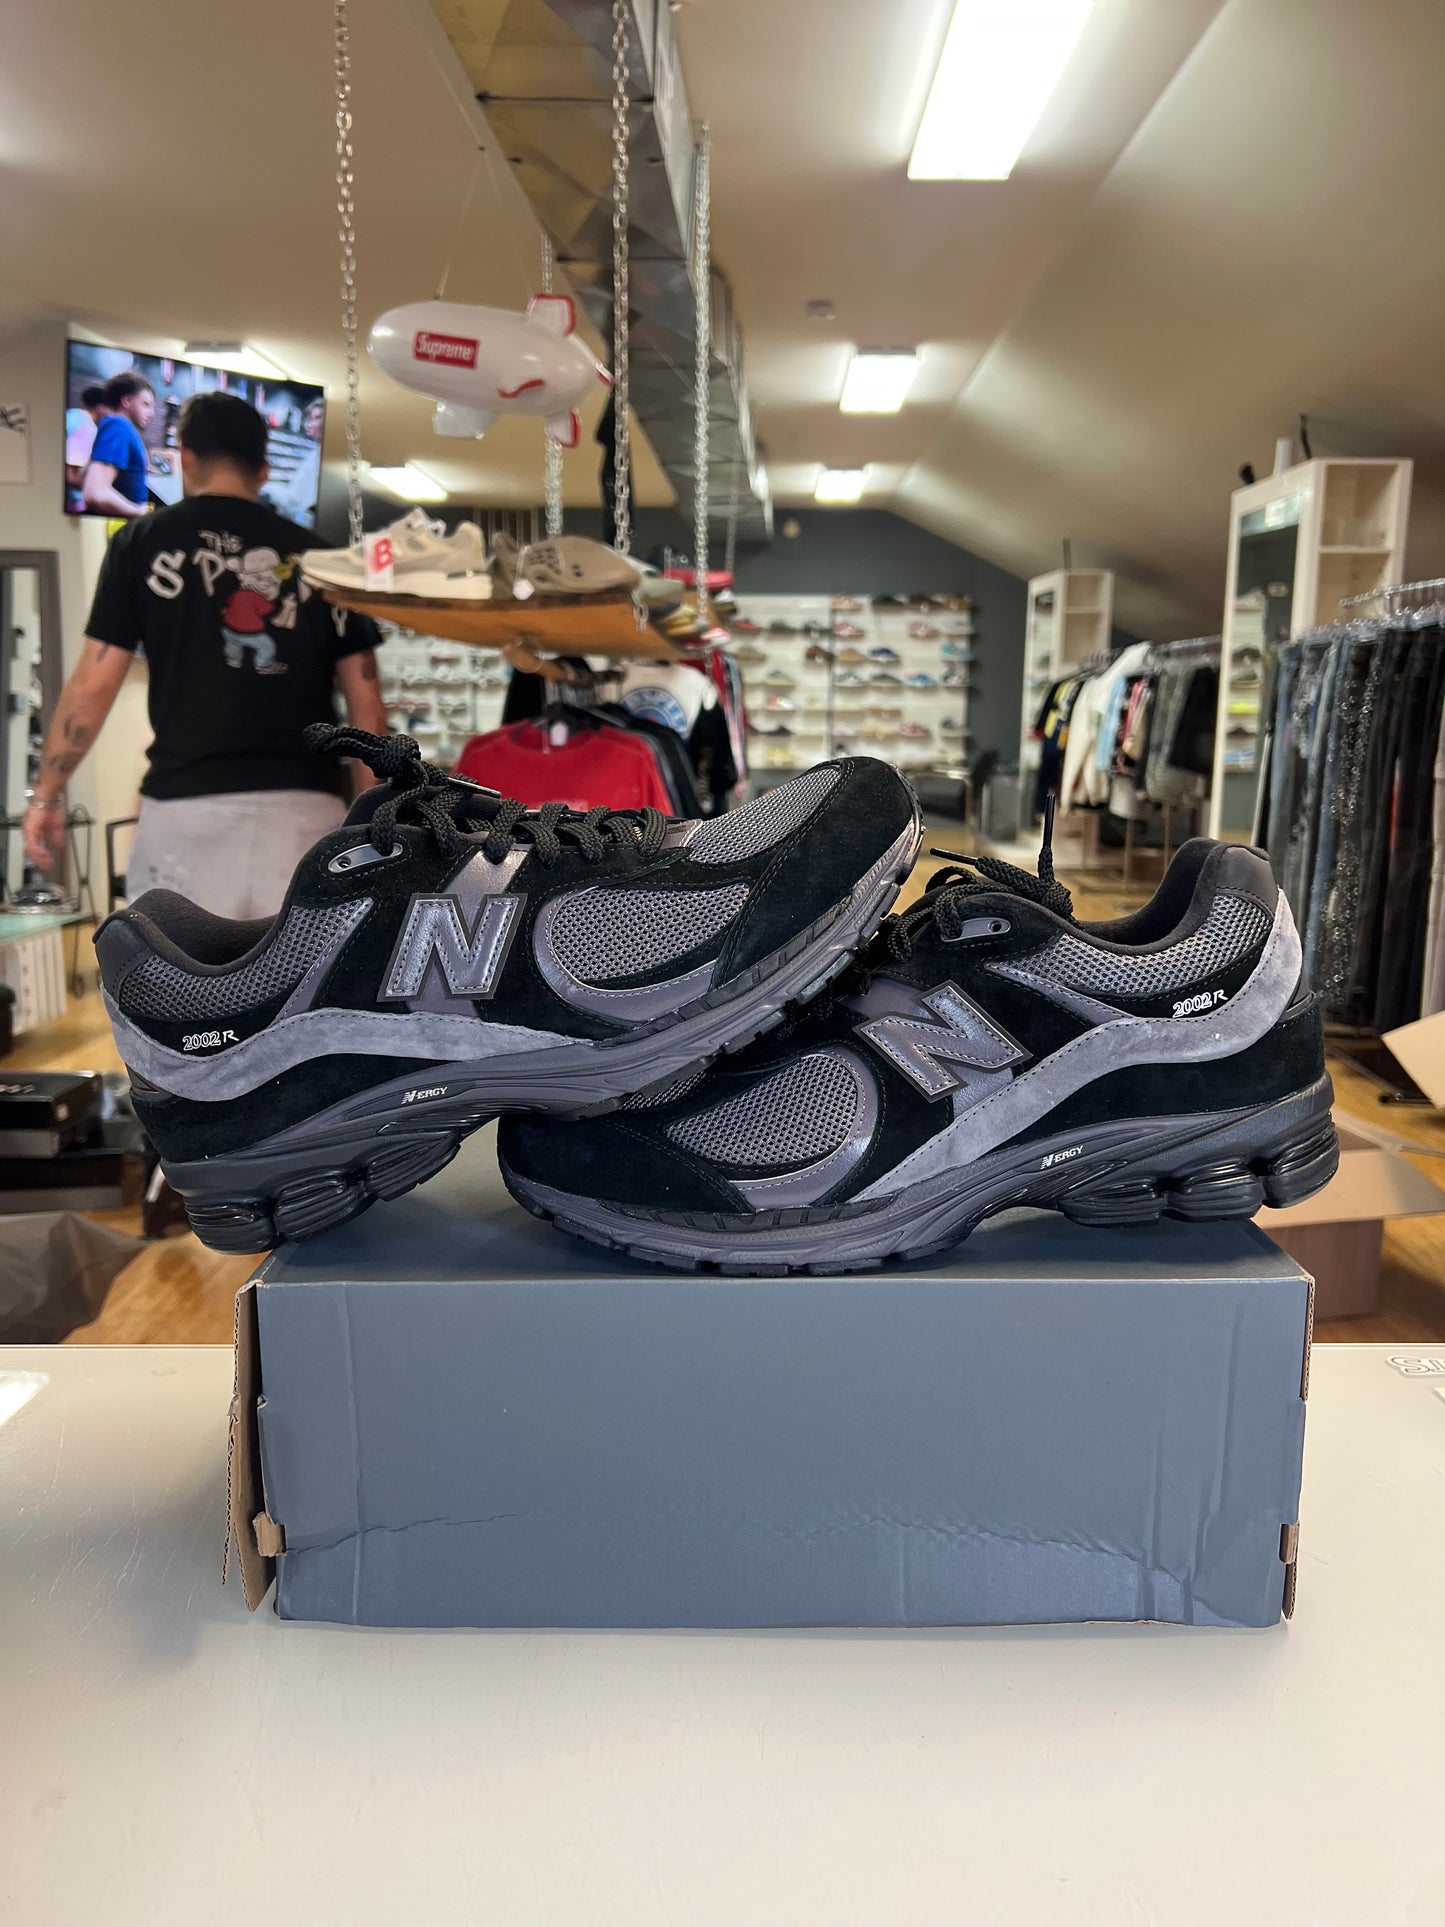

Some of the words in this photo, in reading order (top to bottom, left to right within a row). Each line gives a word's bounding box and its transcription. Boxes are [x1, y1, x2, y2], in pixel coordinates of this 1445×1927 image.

[416, 333, 474, 361] Supreme
[378, 893, 527, 1001] N
[855, 982, 1030, 1100] N
